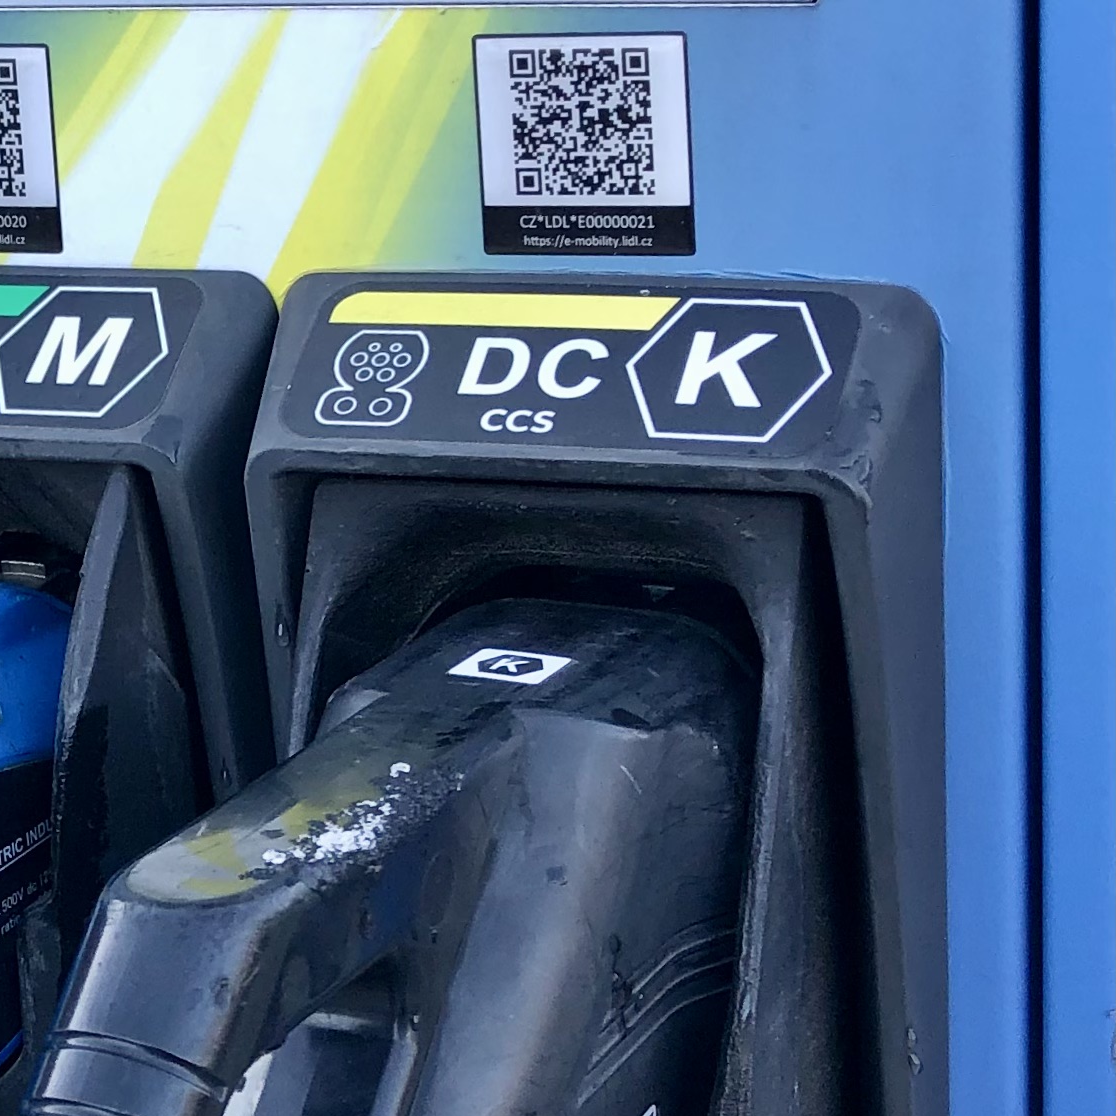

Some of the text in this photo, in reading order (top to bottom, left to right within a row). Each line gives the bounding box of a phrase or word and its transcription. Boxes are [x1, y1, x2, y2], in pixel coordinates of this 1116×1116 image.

[523, 234, 653, 248] https://e-mobility.lidl.cz
[25, 316, 134, 386] M
[457, 336, 610, 399] DC
[674, 330, 779, 408] K
[479, 408, 556, 435] CCS
[489, 657, 530, 673] K
